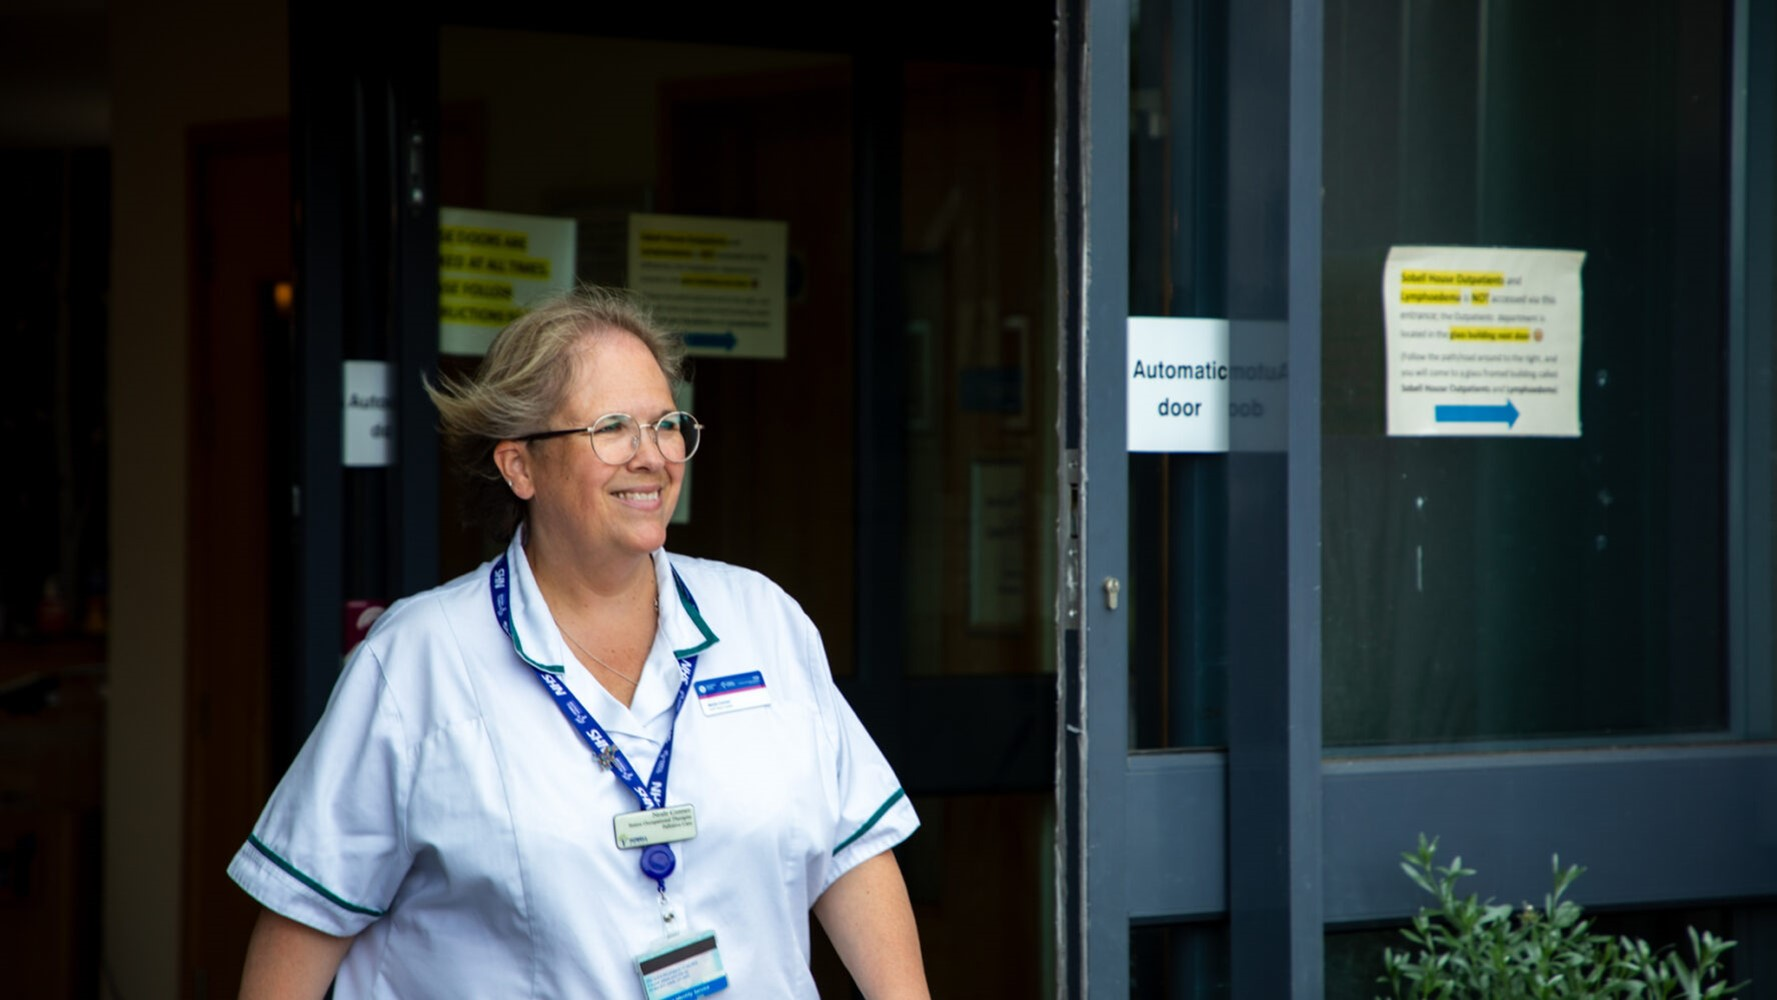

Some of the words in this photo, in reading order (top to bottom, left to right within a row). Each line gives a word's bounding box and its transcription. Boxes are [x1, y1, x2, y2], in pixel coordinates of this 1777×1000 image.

[1429, 273, 1454, 284] House
[1472, 292, 1490, 304] NOT
[1133, 359, 1228, 380] Automatic
[1158, 398, 1202, 417] door
[494, 567, 506, 590] NHS
[541, 673, 568, 697] NHS
